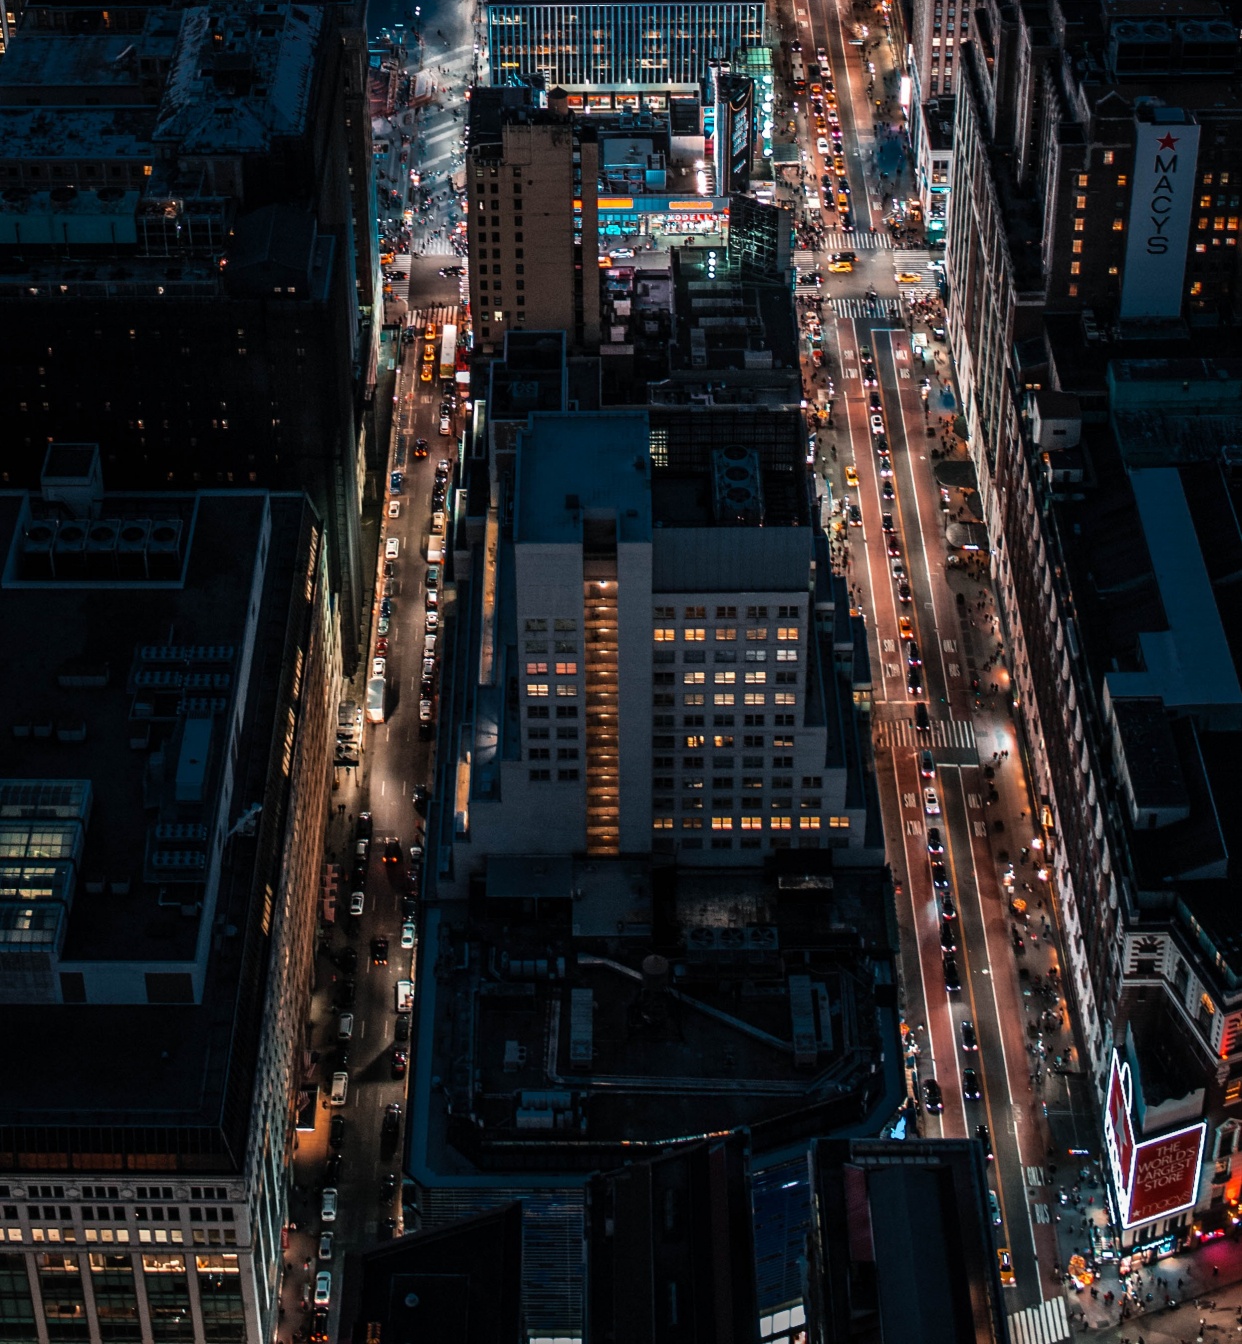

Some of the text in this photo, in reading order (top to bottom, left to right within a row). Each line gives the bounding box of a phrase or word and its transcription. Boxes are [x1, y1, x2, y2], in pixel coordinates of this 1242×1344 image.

[1156, 1141, 1181, 1157] THE
[1136, 1157, 1194, 1185] LARGEST
[1144, 1171, 1184, 1192] STORE
